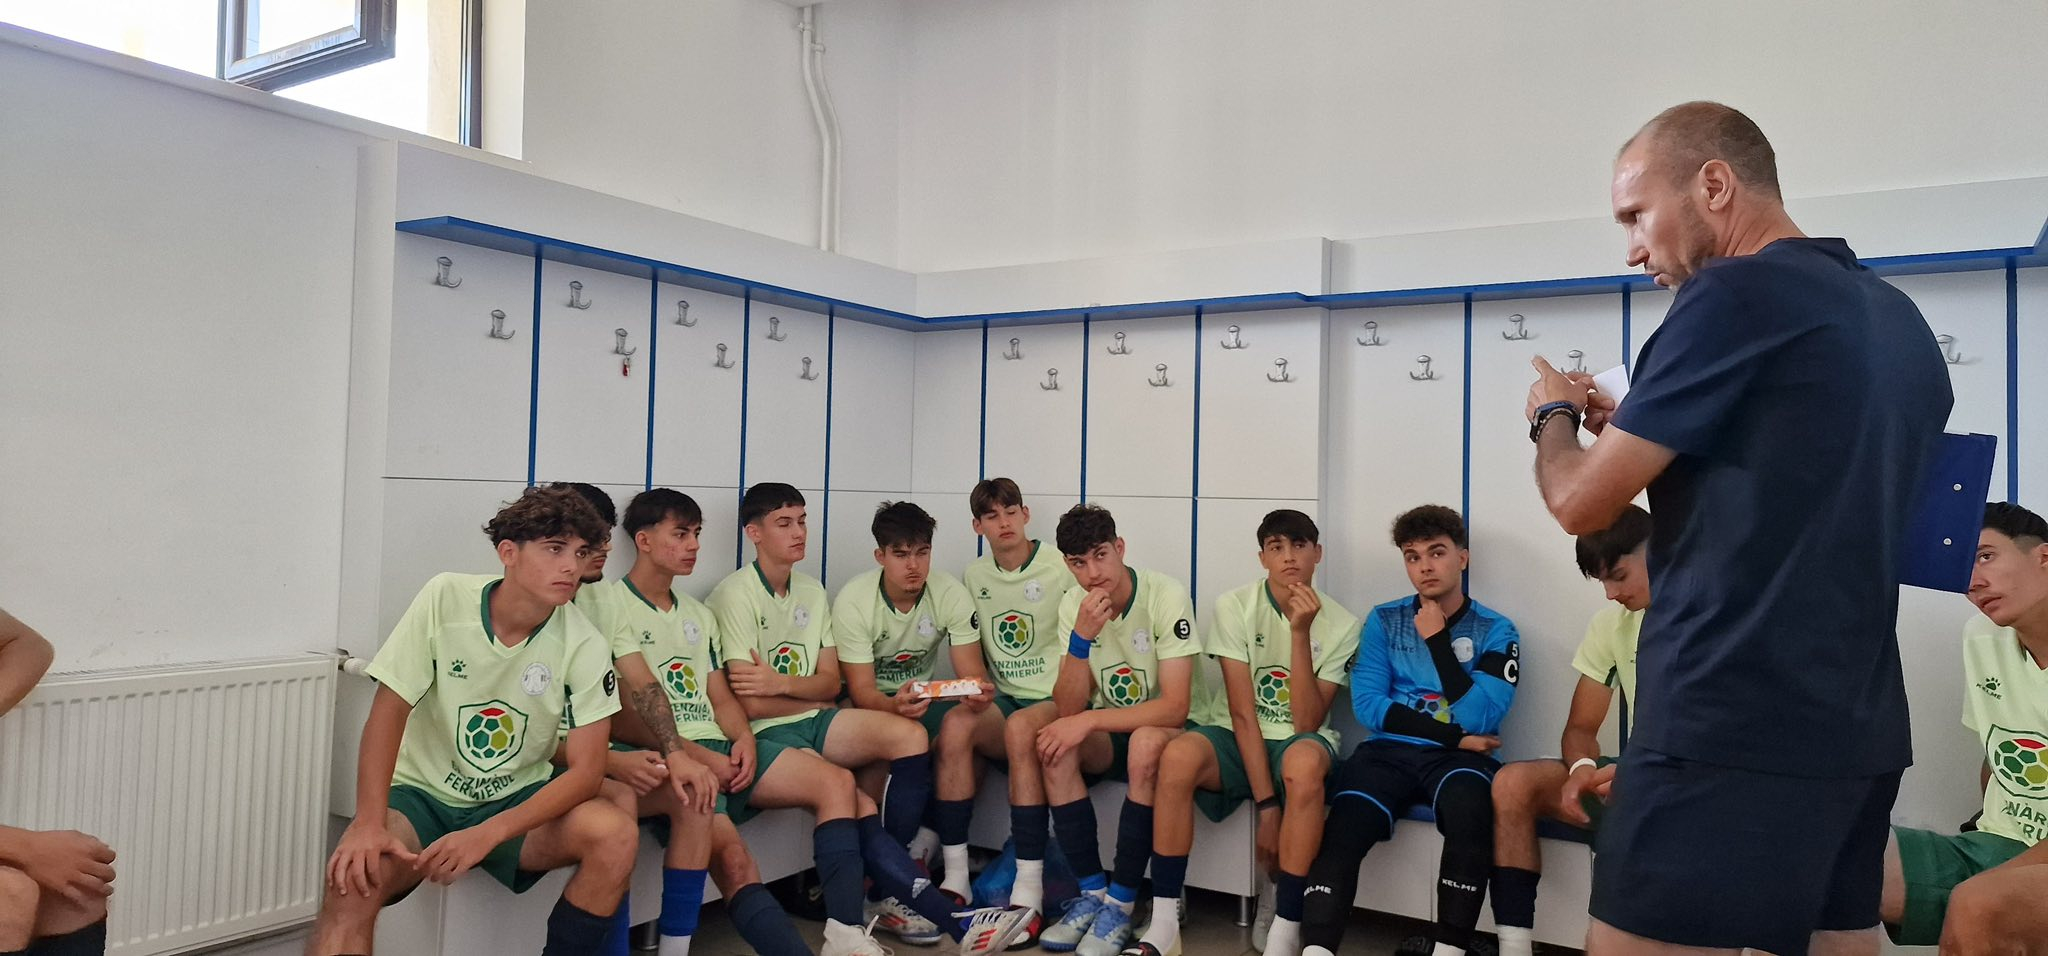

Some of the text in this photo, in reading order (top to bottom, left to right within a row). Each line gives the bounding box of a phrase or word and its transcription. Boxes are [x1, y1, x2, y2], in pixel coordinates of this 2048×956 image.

[1180, 620, 1189, 635] 5
[1512, 643, 1519, 657] 5
[1504, 659, 1518, 683] C
[1976, 683, 2001, 700] KELME
[1442, 879, 1477, 891] KELME
